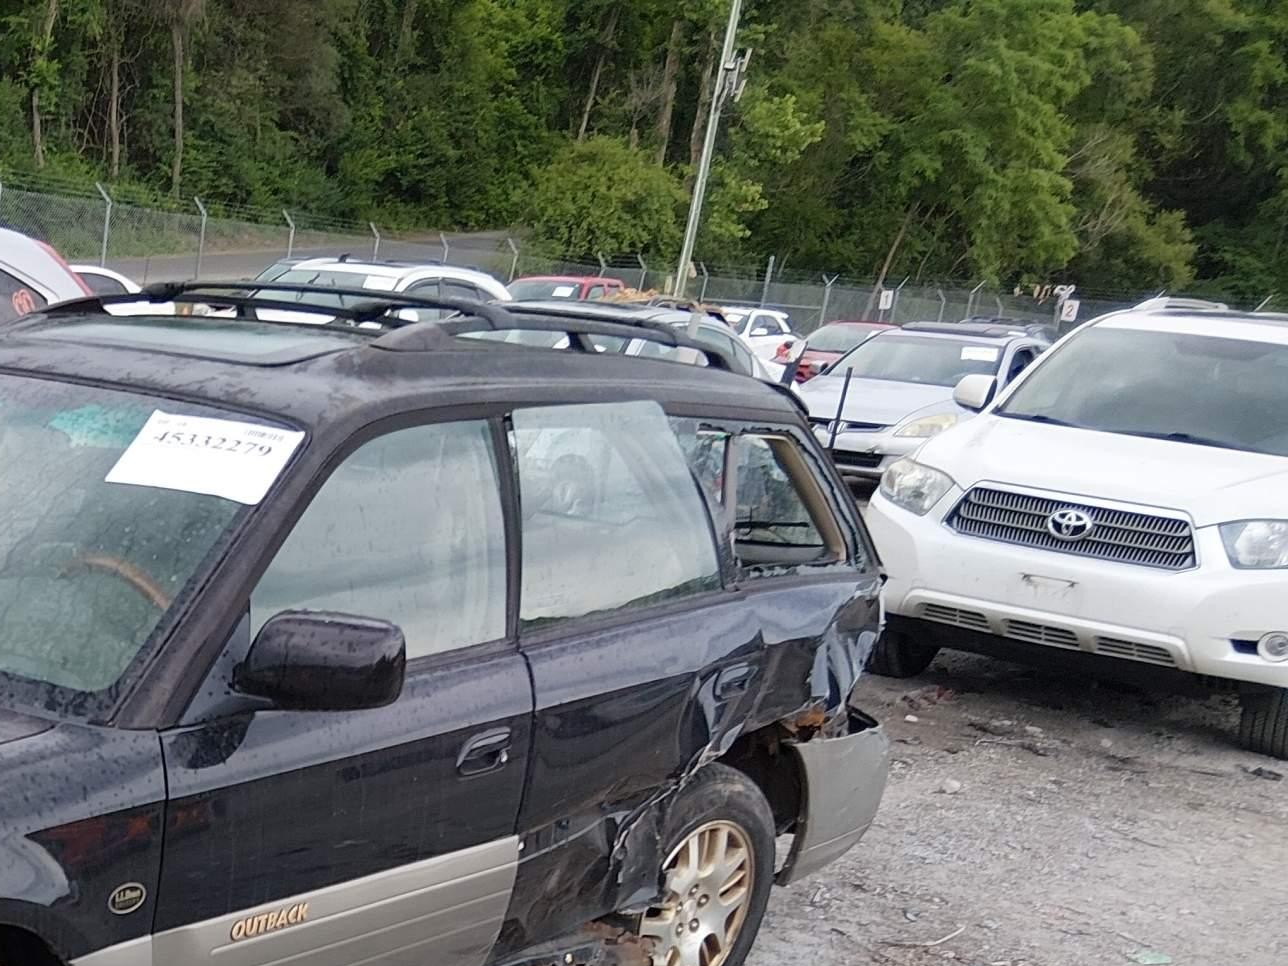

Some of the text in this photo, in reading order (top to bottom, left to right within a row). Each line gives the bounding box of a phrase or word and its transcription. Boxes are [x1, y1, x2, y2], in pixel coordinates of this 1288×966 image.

[1064, 304, 1074, 318] 2
[153, 431, 273, 456] 45332279
[231, 903, 309, 940] OUTBACK
